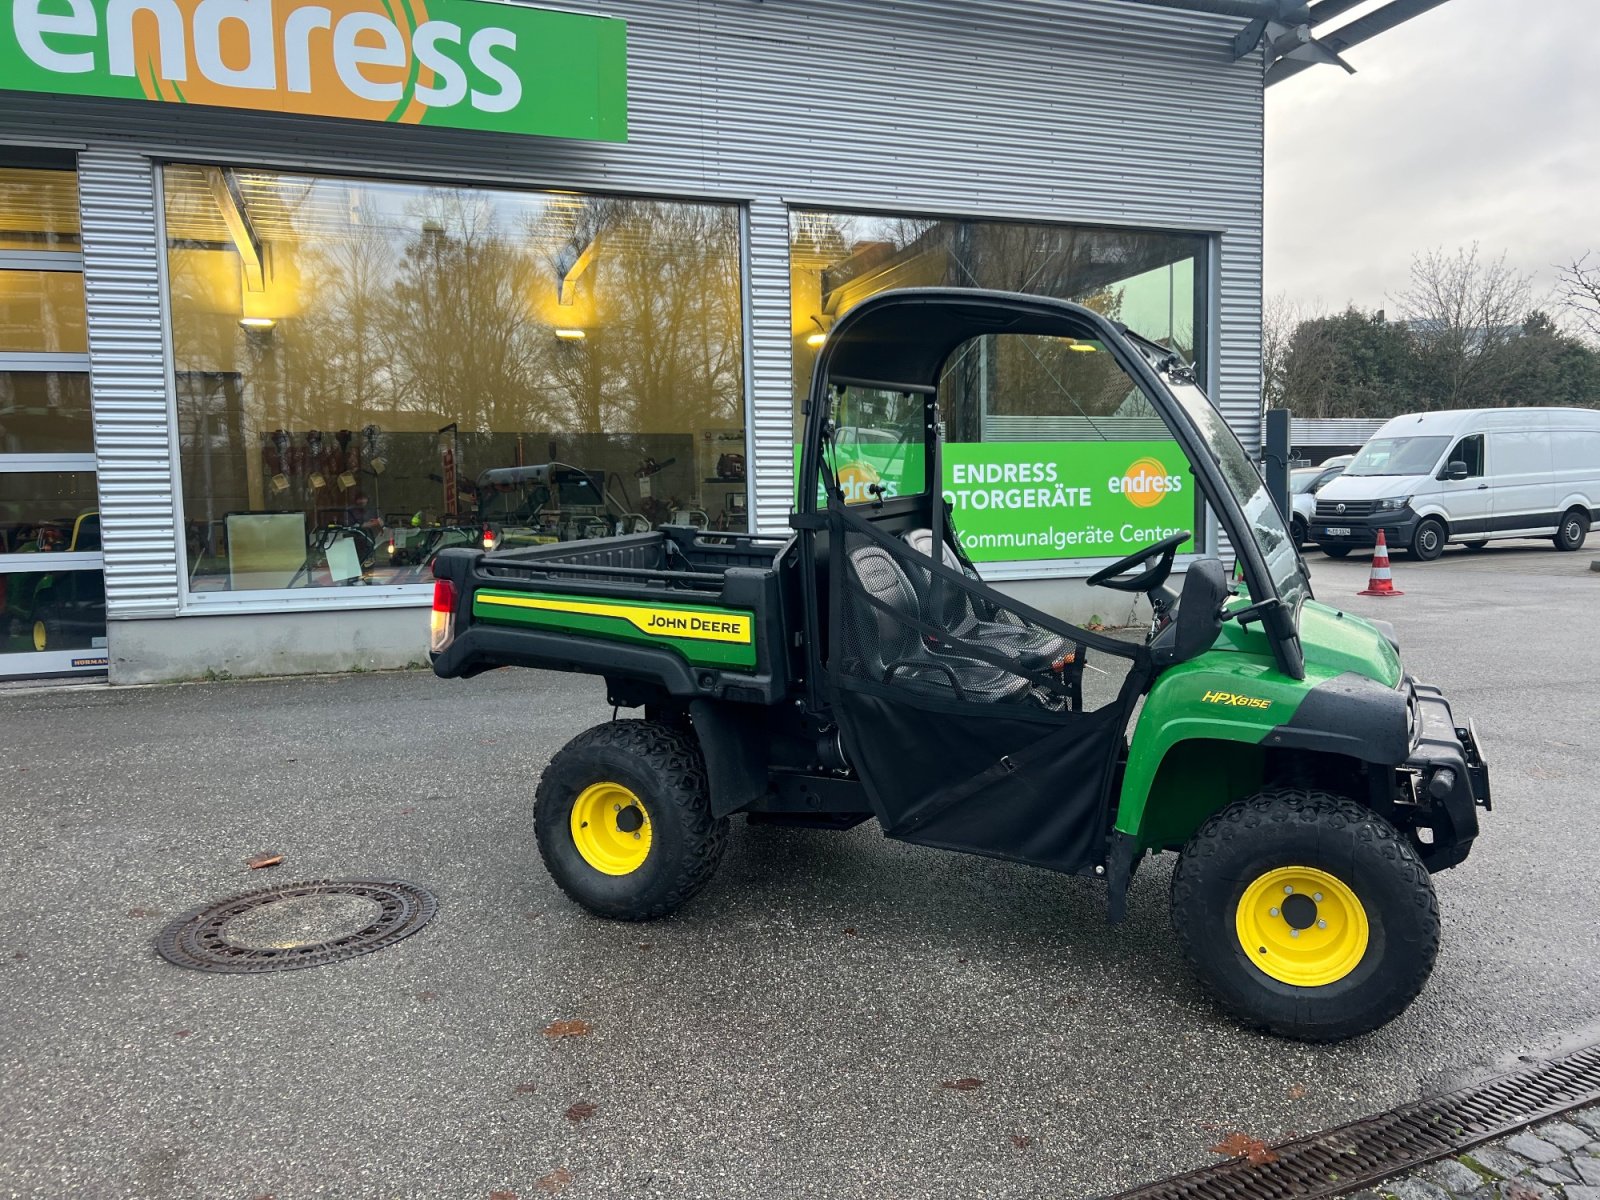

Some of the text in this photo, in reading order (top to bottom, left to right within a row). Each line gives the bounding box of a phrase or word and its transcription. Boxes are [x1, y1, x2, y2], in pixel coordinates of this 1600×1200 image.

[12, 0, 523, 113] endress
[953, 463, 1058, 484] ENDRESS
[1108, 469, 1182, 494] endress
[941, 483, 1092, 510] OTORGERÄTE
[648, 614, 741, 634] JOHN DEERE
[1202, 690, 1272, 709] HPX815E
